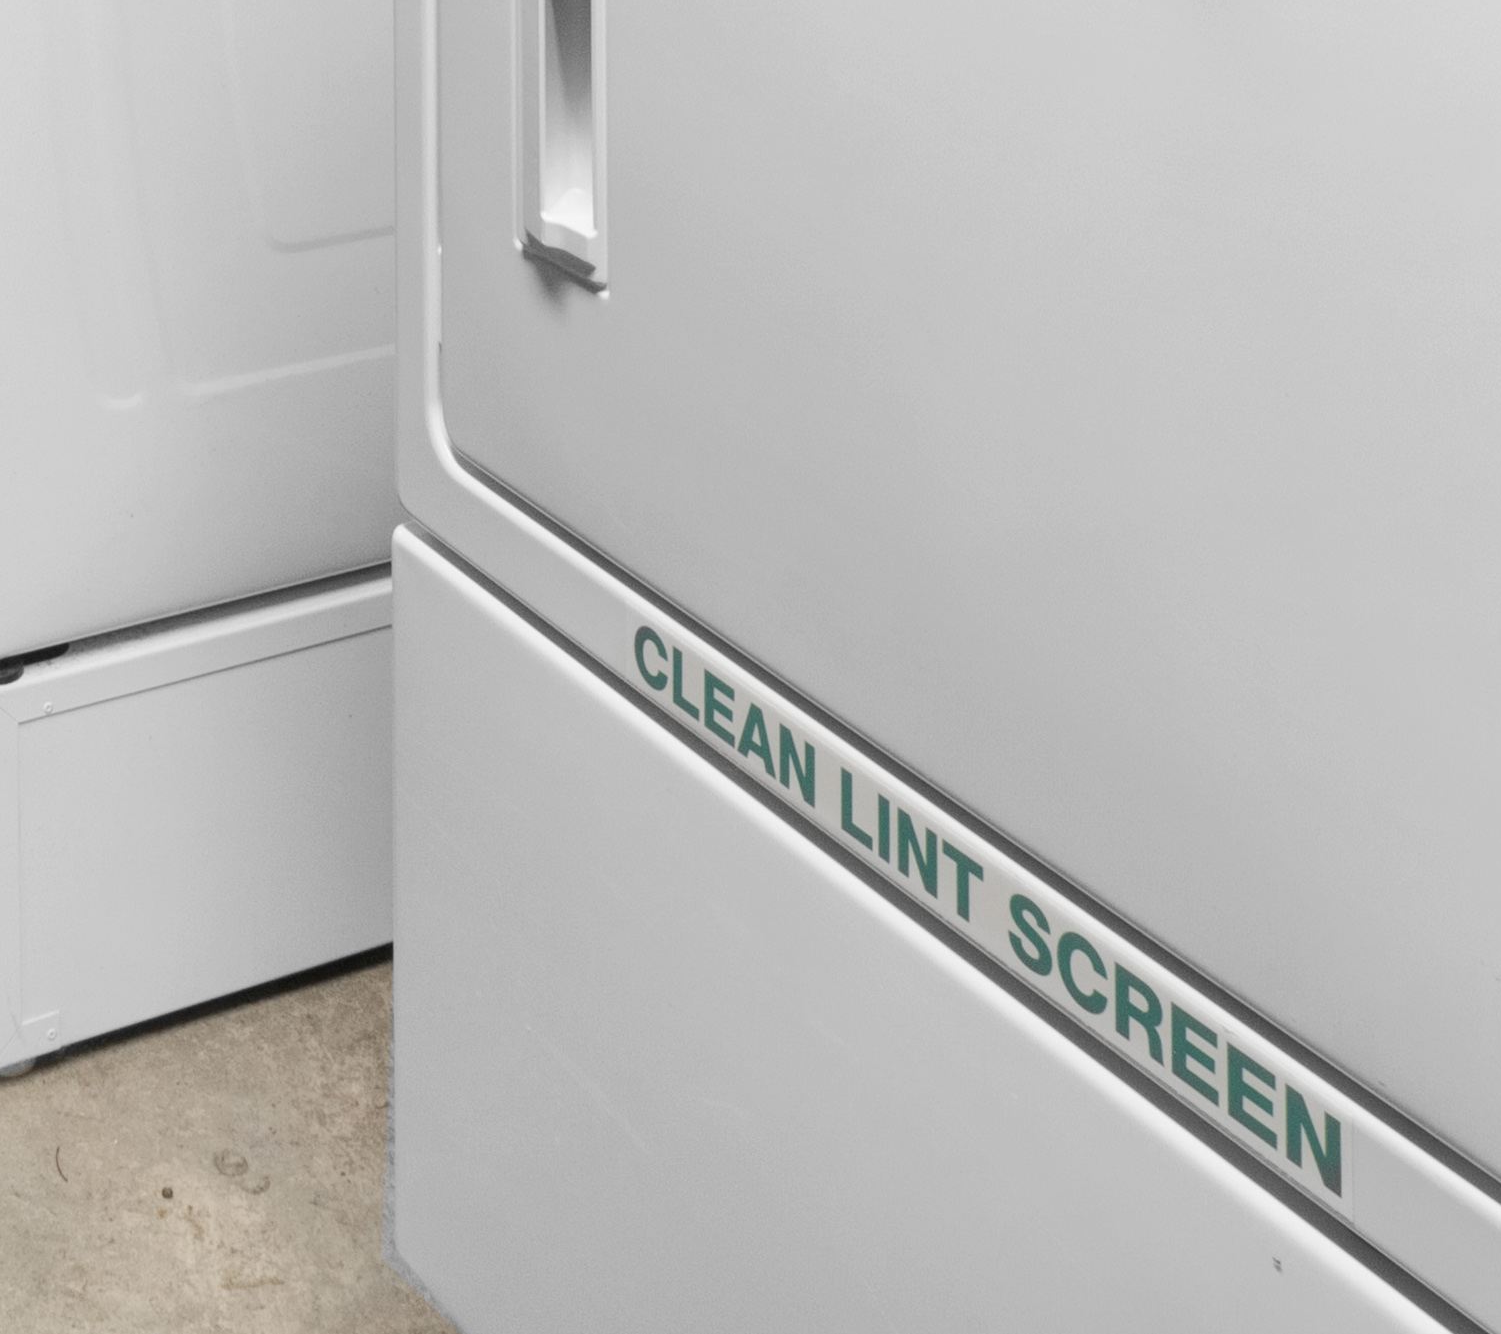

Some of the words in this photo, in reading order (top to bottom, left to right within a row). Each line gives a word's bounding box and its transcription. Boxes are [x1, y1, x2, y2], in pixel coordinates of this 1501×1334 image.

[634, 625, 816, 809] CLEAN
[840, 766, 985, 923] LINT
[1008, 893, 1343, 1198] SCREEN
